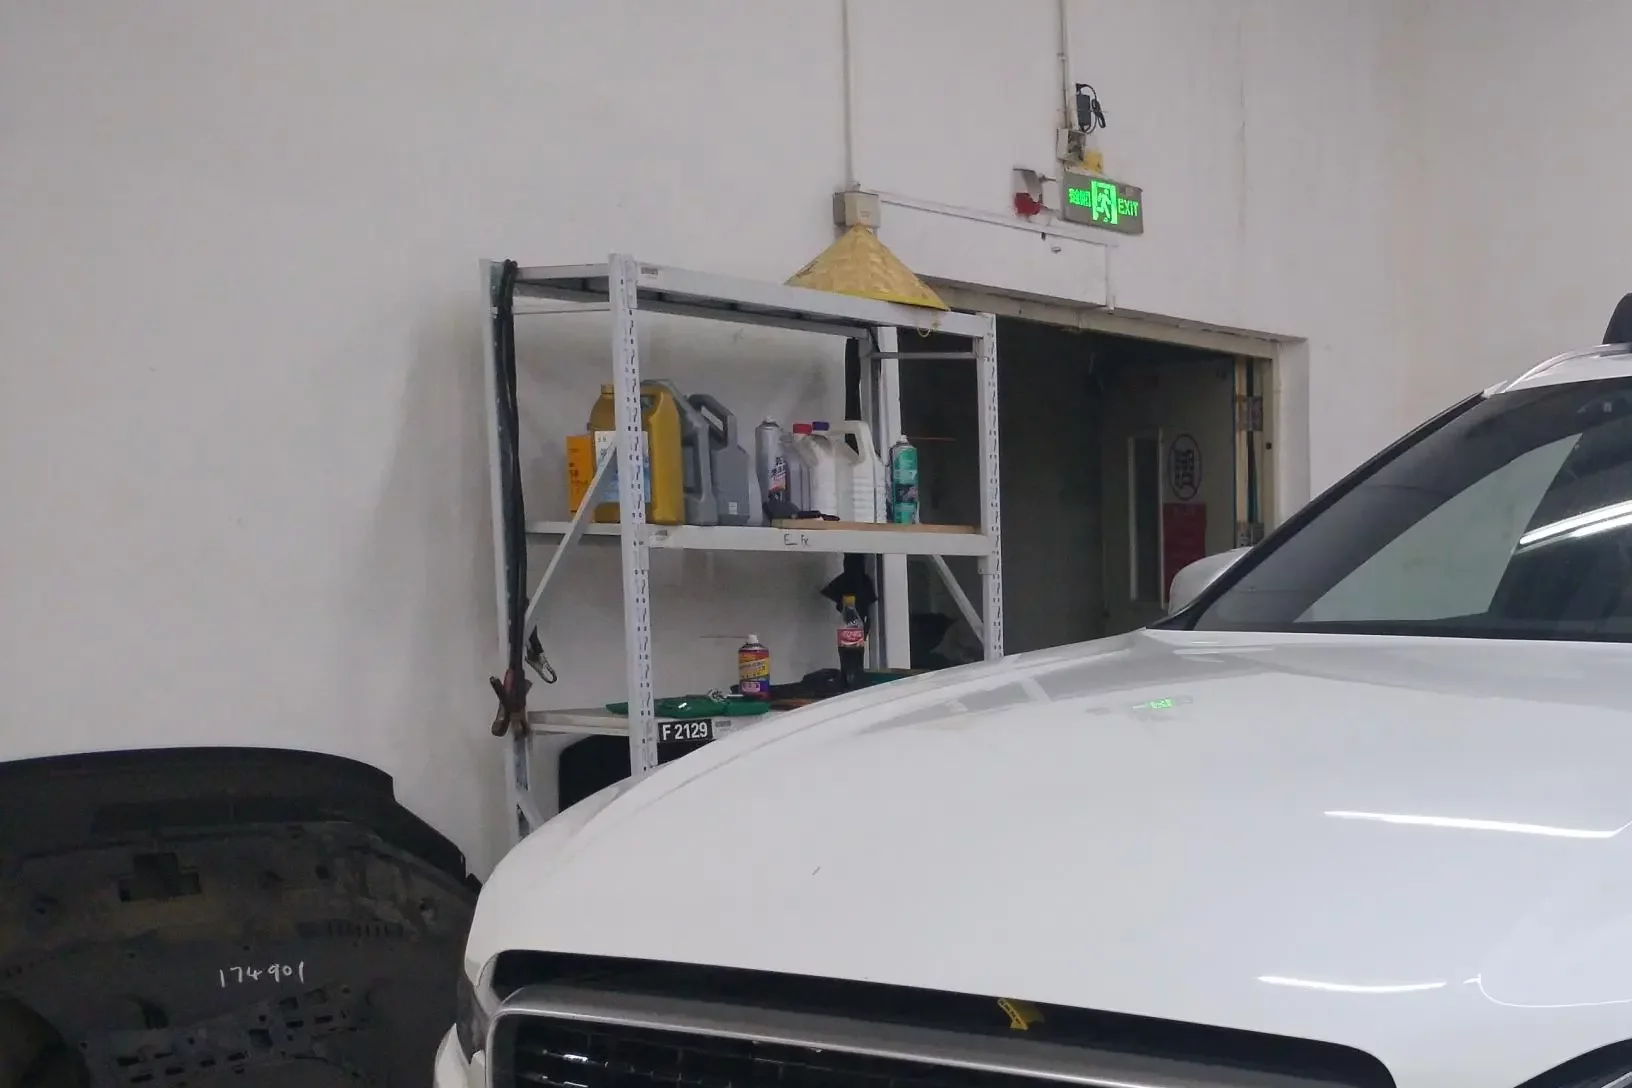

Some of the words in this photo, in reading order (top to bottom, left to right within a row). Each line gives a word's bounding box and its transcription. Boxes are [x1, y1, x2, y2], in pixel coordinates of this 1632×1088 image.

[1117, 198, 1139, 217] EXIT
[662, 724, 671, 741] F
[674, 721, 708, 740] 2129
[219, 961, 305, 988] 174901
